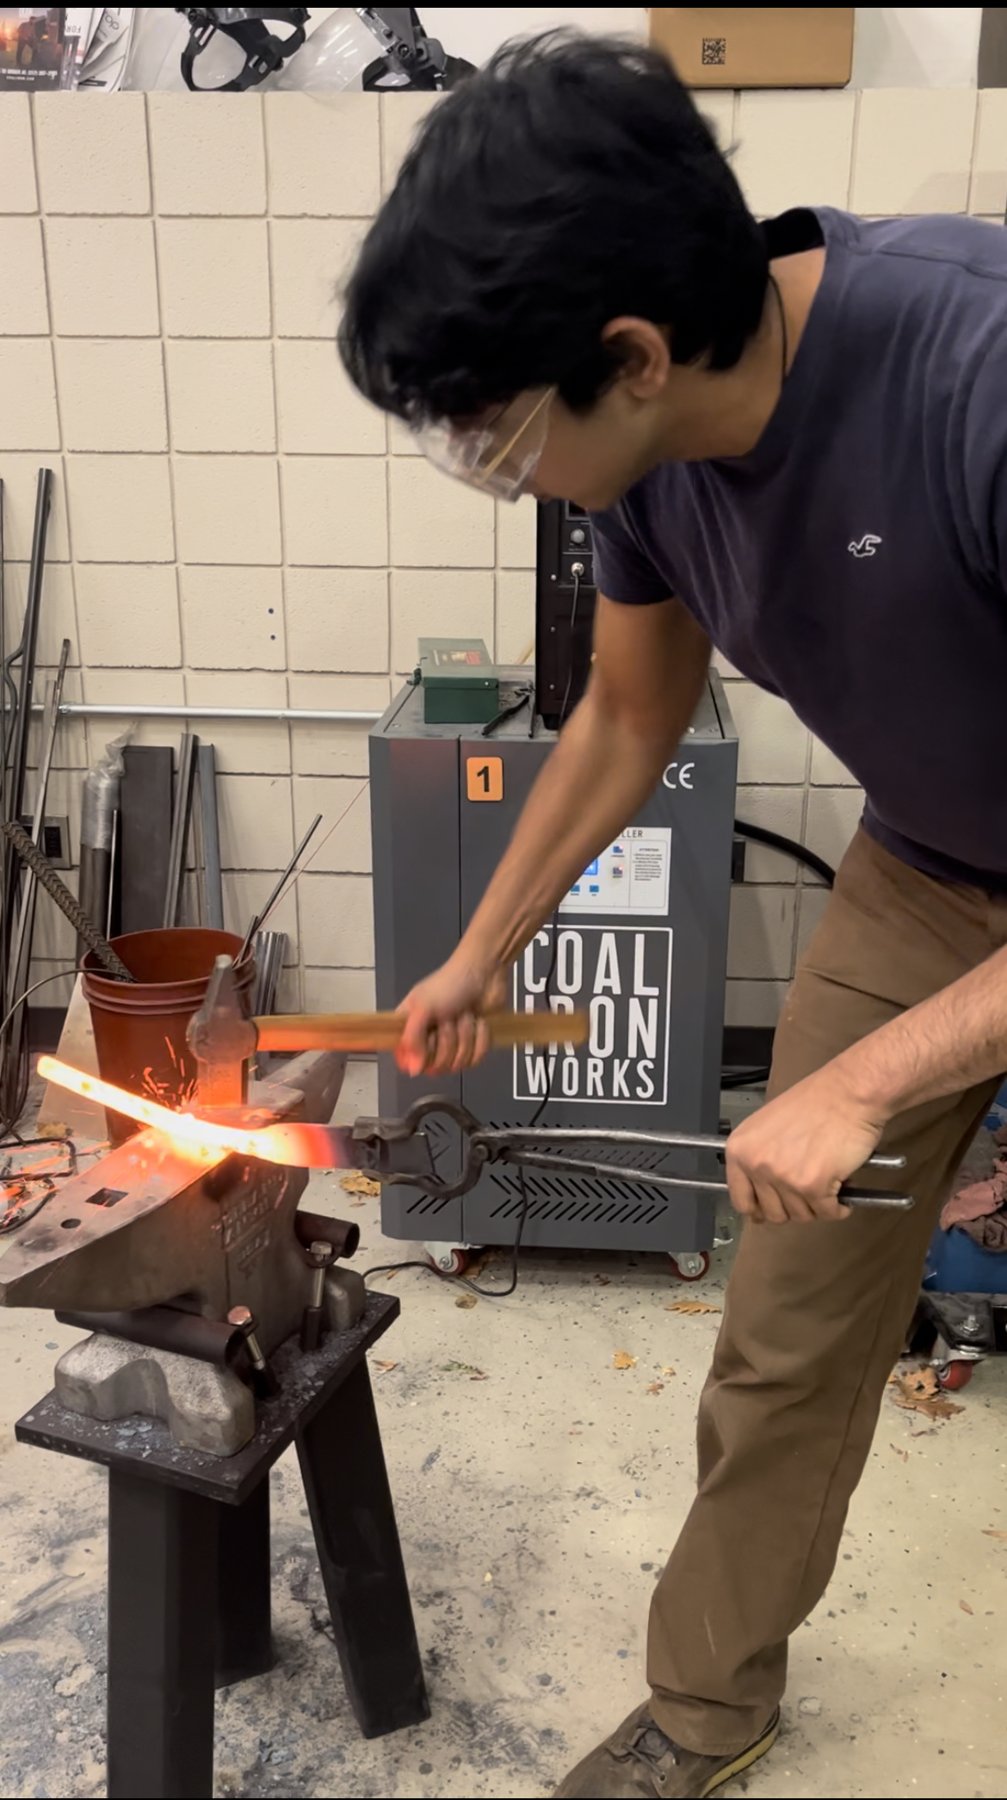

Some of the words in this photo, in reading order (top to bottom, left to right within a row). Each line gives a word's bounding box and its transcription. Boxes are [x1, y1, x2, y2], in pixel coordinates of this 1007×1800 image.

[476, 765, 490, 792] 1
[662, 762, 695, 789] CE
[524, 930, 659, 996] COAL
[524, 1055, 655, 1098] WORKS
